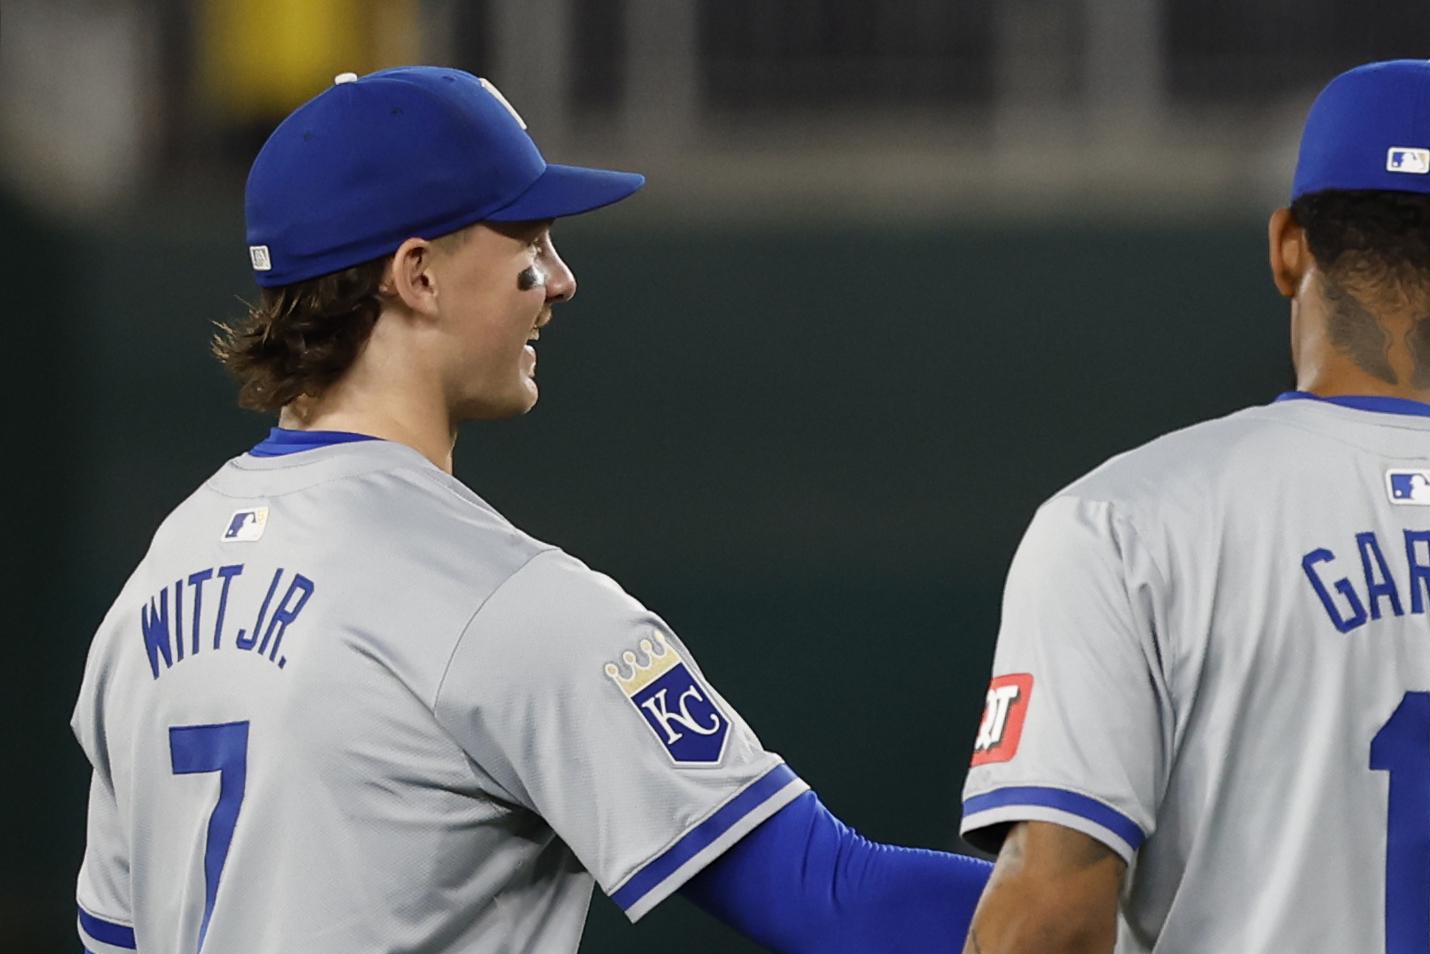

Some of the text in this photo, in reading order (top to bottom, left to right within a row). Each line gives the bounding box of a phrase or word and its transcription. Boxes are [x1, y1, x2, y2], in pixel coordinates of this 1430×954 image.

[141, 563, 315, 680] WITT JR.
[641, 684, 720, 745] KC
[170, 720, 251, 953] 7
